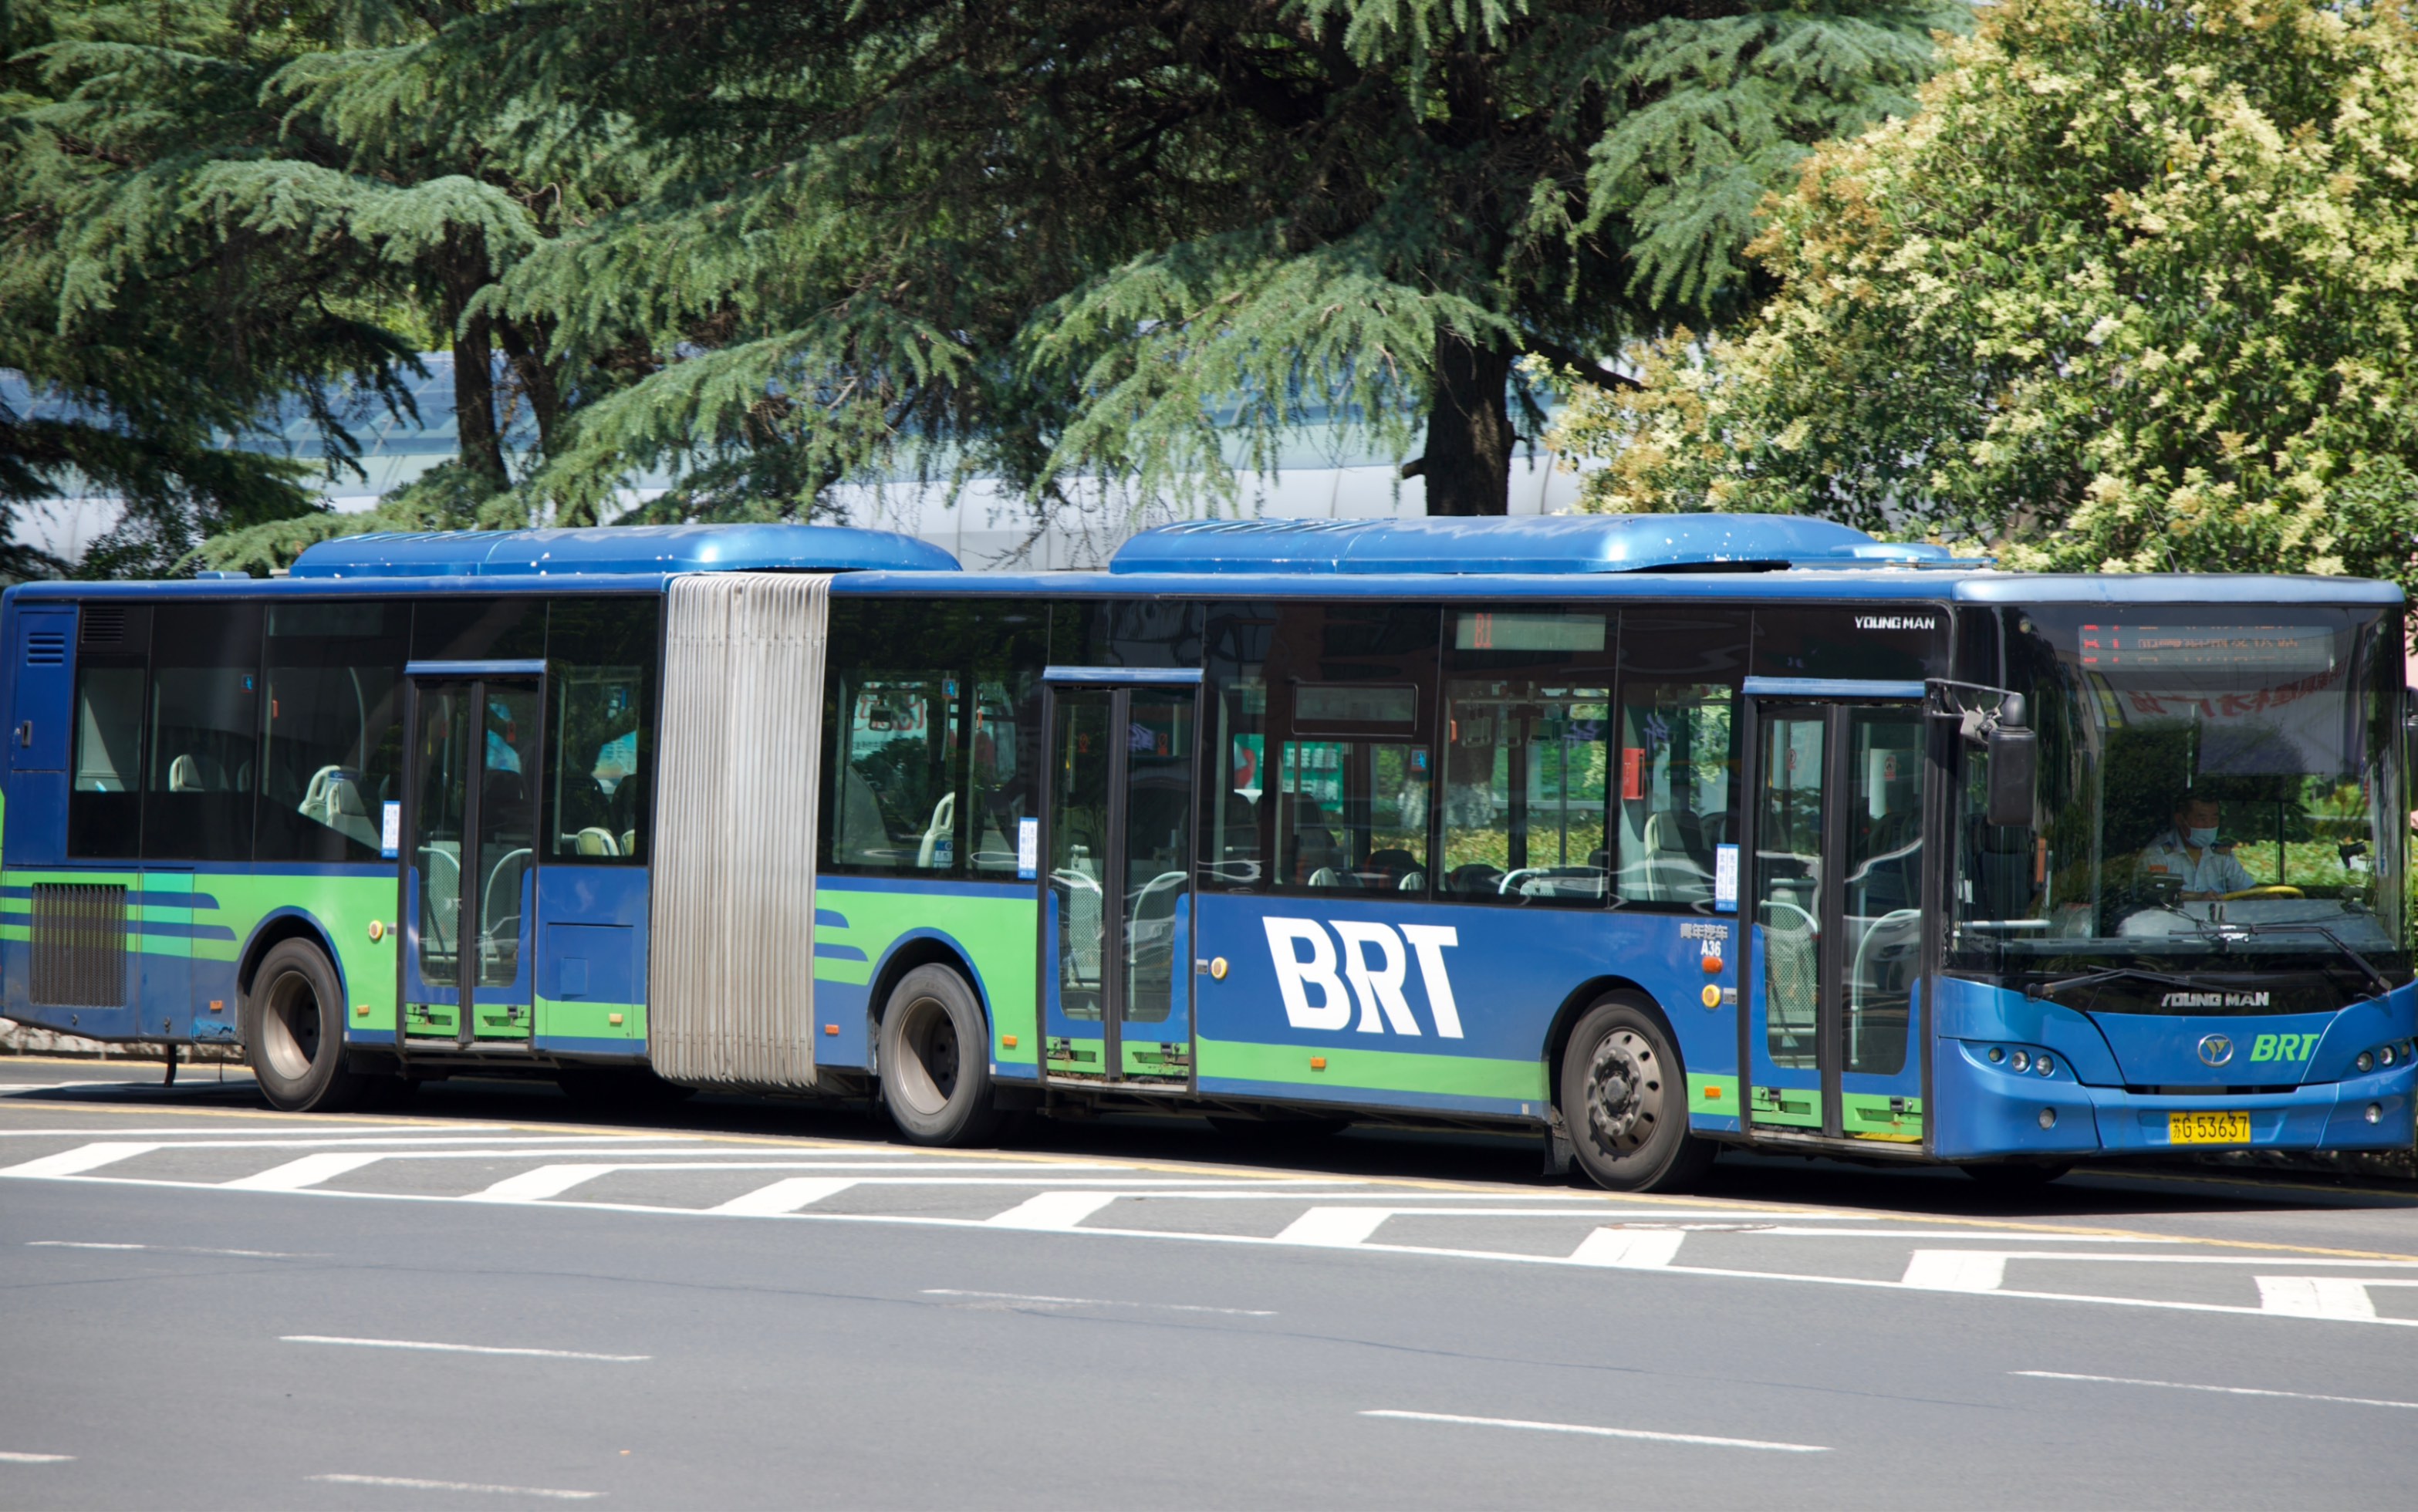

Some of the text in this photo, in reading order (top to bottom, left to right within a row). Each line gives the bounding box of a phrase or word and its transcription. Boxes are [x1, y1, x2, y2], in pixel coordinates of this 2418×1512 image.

[1680, 923, 1727, 940] 青年汽车
[1700, 940, 1721, 957] A36
[1262, 916, 1464, 1038] BRT
[2225, 992, 2269, 1006] MAN
[2250, 1034, 2320, 1061] BRT
